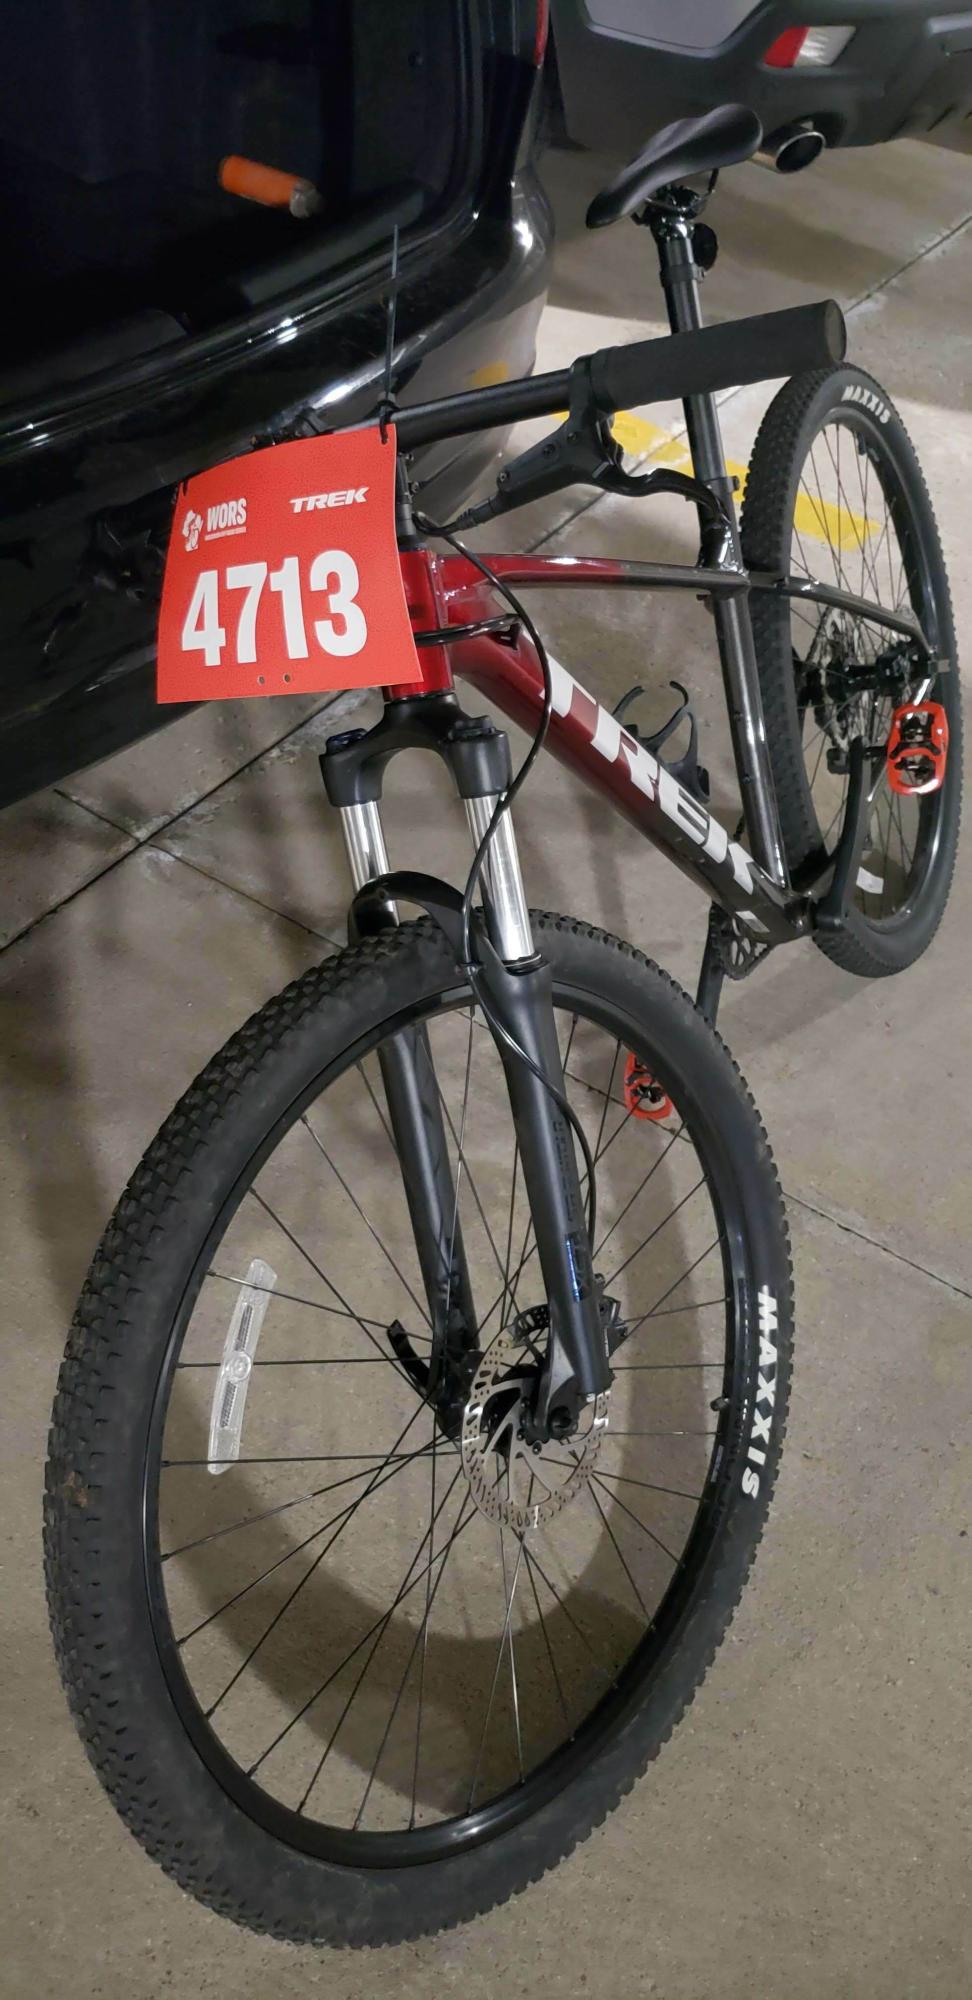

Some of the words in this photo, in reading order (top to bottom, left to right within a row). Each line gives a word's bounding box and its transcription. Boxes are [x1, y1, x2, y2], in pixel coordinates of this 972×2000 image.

[841, 384, 891, 424] MAXXIS
[206, 497, 247, 533] WORS
[289, 486, 369, 514] TREK
[181, 549, 368, 667] 4713
[520, 626, 755, 896] TREK
[741, 1290, 778, 1500] MAXXIS
